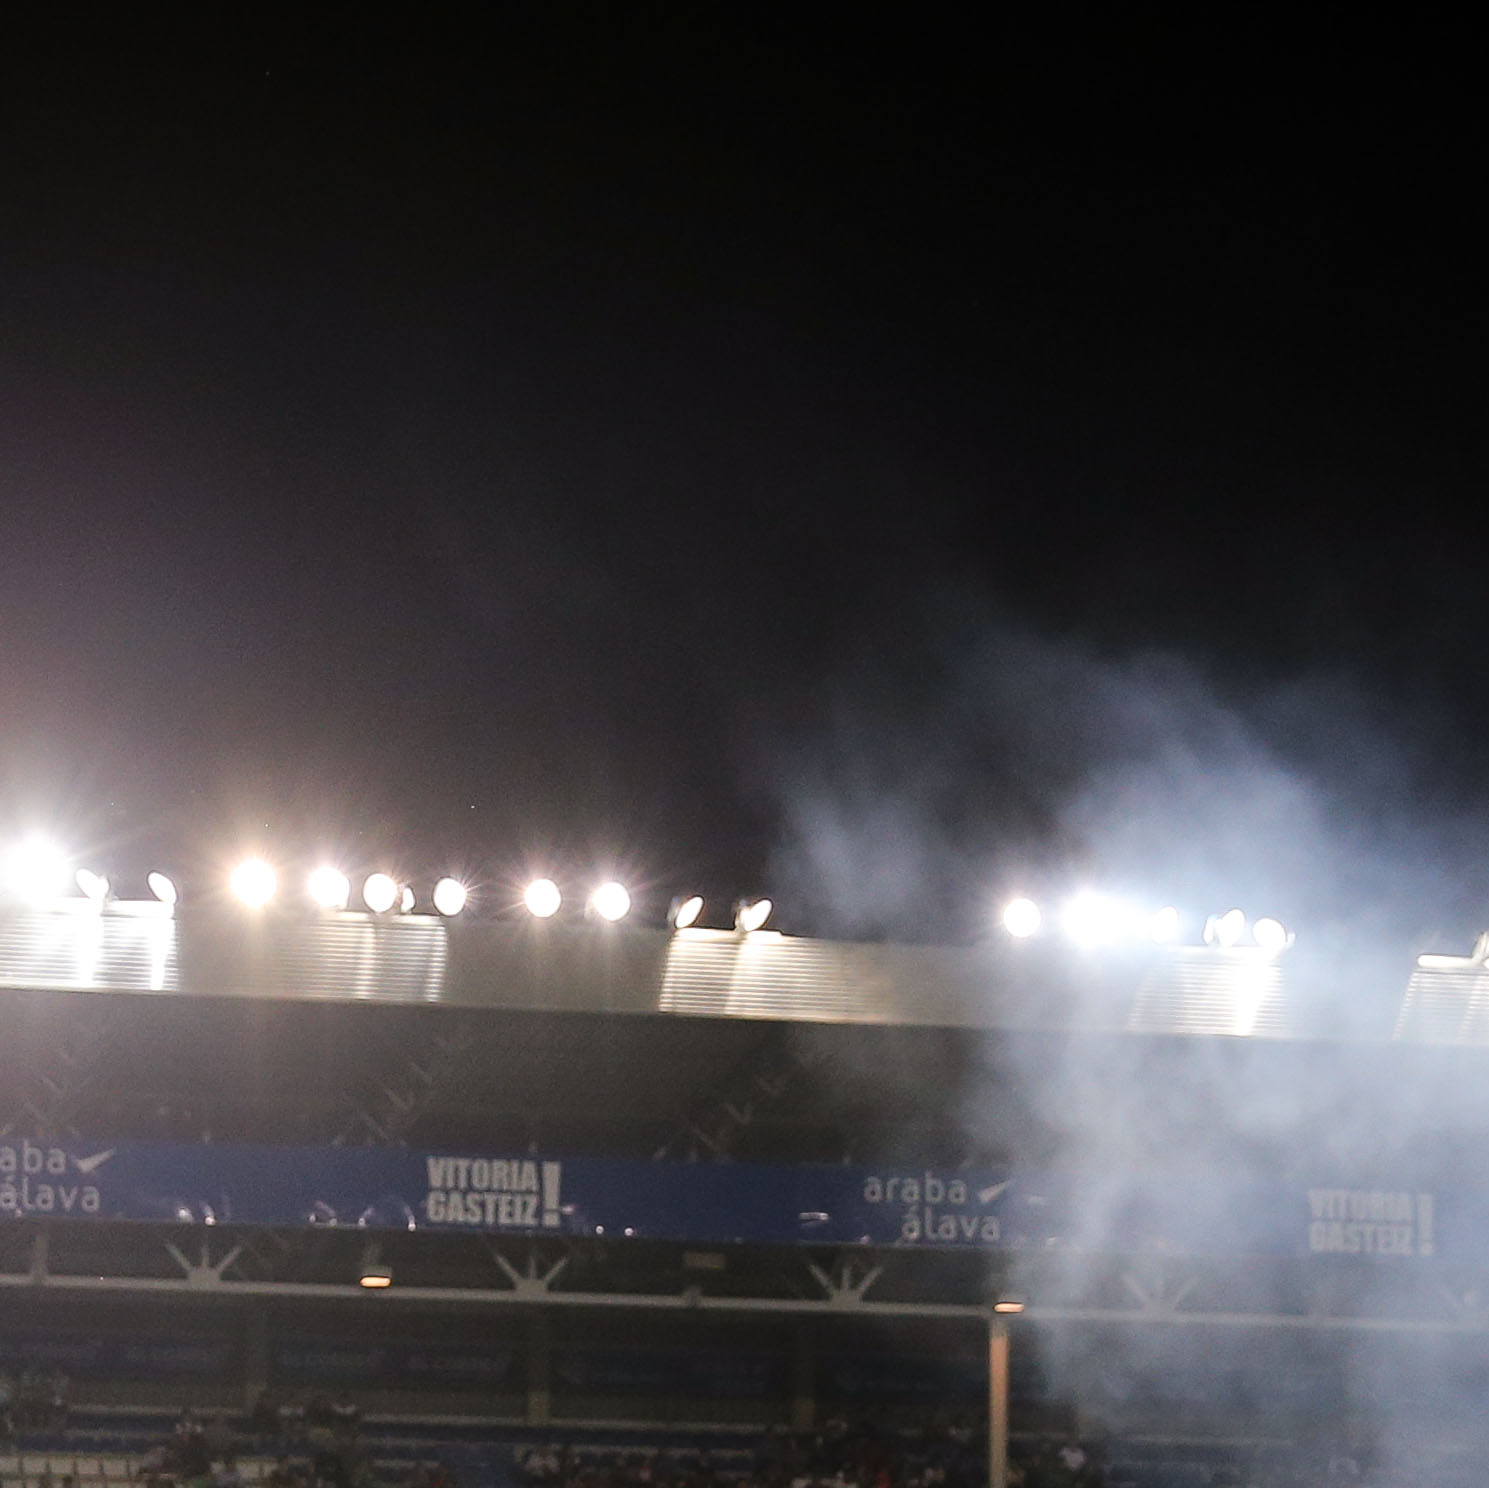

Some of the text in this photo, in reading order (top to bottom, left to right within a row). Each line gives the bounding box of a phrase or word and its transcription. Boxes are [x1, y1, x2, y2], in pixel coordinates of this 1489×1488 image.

[427, 1156, 538, 1191] VITORIA
[864, 1170, 967, 1204] araba
[427, 1190, 539, 1226] GASTEIZ
[901, 1205, 1000, 1241] álava
